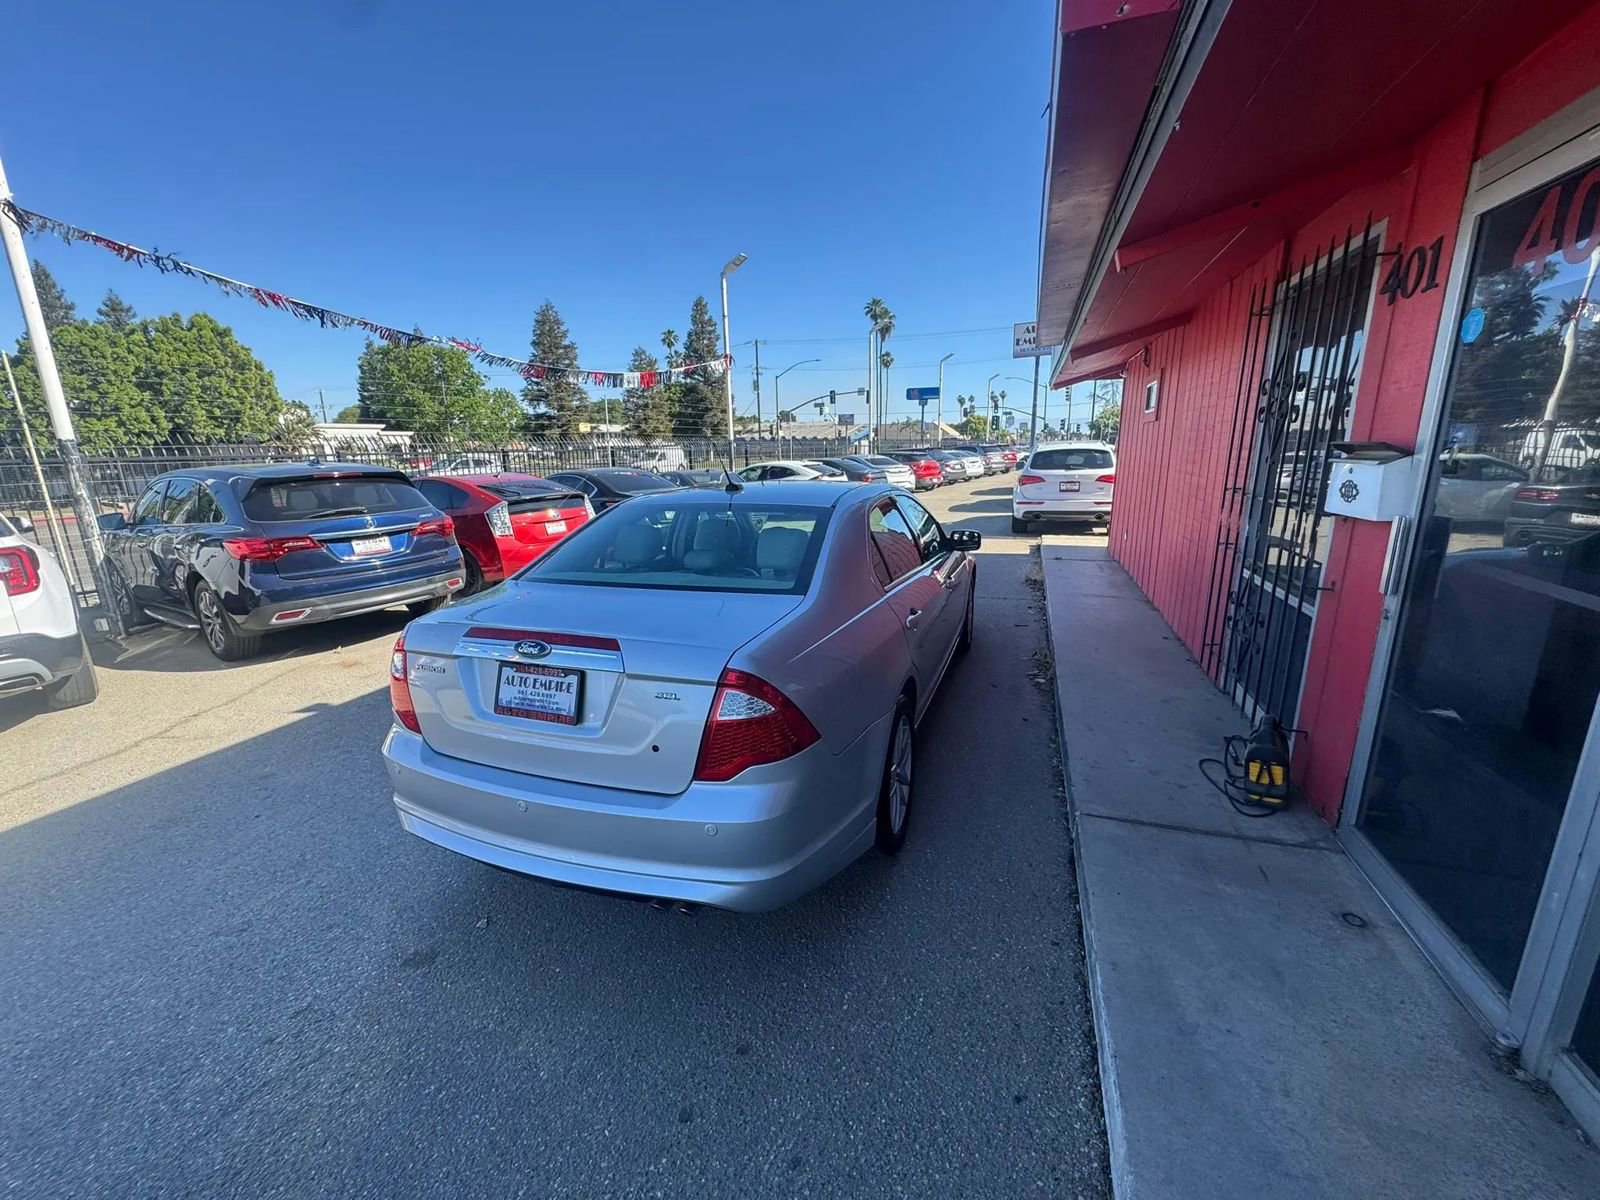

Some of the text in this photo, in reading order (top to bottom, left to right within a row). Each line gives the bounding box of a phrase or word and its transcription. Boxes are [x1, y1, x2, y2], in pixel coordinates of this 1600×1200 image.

[1379, 235, 1444, 307] 401
[518, 642, 540, 654] Ford
[504, 674, 574, 694] AUTO EMPIRE
[496, 707, 574, 725] AUTO EMPIRE
